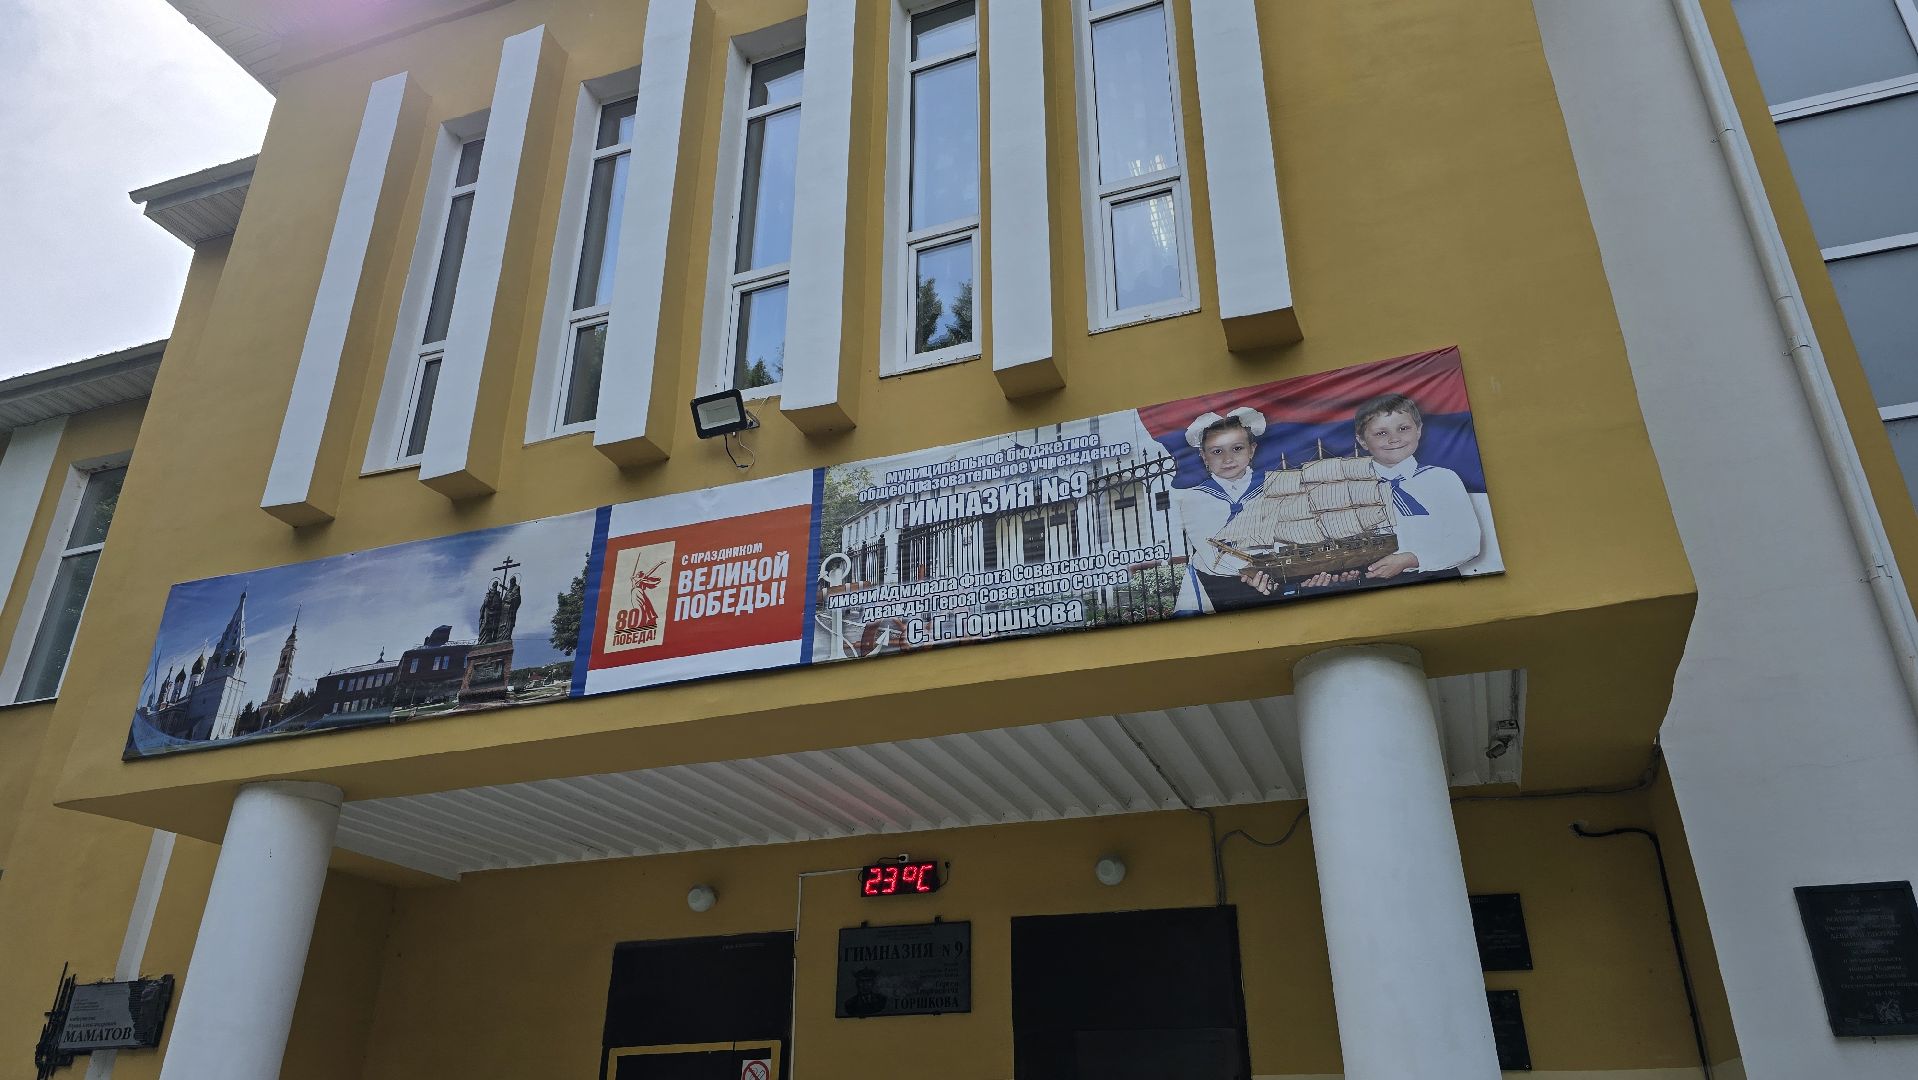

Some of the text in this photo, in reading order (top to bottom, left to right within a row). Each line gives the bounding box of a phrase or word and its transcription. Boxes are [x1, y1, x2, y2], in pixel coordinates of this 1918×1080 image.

[858, 442, 1131, 503] общеобразовательное учреждение
[886, 434, 1099, 484] муниципальное бюджетное
[895, 470, 1088, 529] ГИМНАЗИЯ №9
[677, 550, 790, 595] ВЕЛИКОЙ
[681, 543, 763, 565] С ПРАЗДНИКОМ
[828, 589, 878, 609] имени
[879, 576, 958, 601] Адмирала
[1013, 554, 1106, 581] Советского
[1108, 544, 1170, 566] Союза,
[862, 569, 1129, 623] дважды Героя Советского Союза
[615, 608, 641, 631] 80
[673, 580, 787, 622] ПОБЕДЫ!
[907, 599, 1084, 644] С. Г. Горшкова
[612, 629, 657, 647] ПОБЕДА!
[844, 942, 934, 962] ГИМНАЗИЯ
[894, 996, 959, 1010] ГОРШКОВА
[63, 1027, 132, 1043] МАМАТОВ
